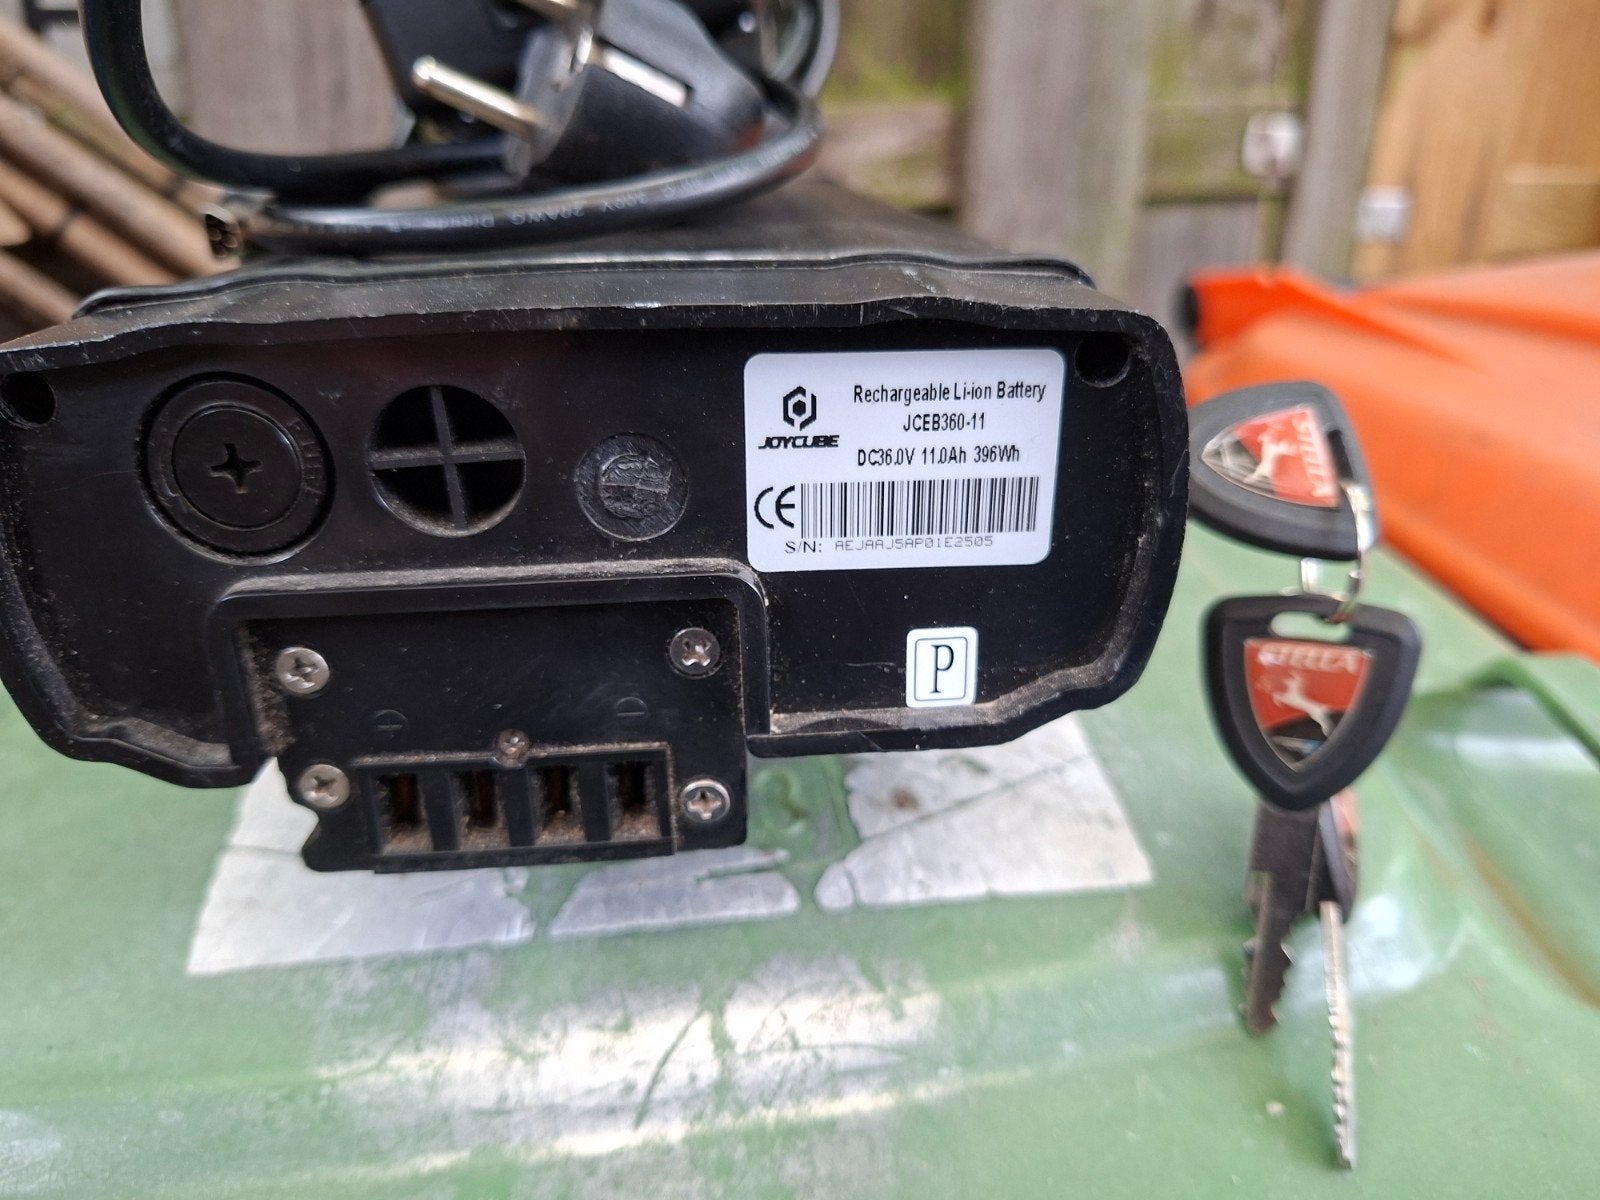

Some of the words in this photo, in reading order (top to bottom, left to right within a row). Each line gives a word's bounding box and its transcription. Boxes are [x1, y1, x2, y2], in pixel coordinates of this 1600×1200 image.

[853, 382, 950, 406] Rechargeable
[953, 381, 992, 401] Li-ion
[996, 380, 1047, 403] Battery
[902, 411, 985, 432] JCEB360-11
[758, 434, 840, 449] JOYCUBE
[857, 447, 915, 467] DC36.0V
[921, 446, 967, 465] 11.0Ah
[973, 444, 1020, 464] 396Wh
[784, 539, 822, 554] S/N:
[930, 644, 955, 694] P
